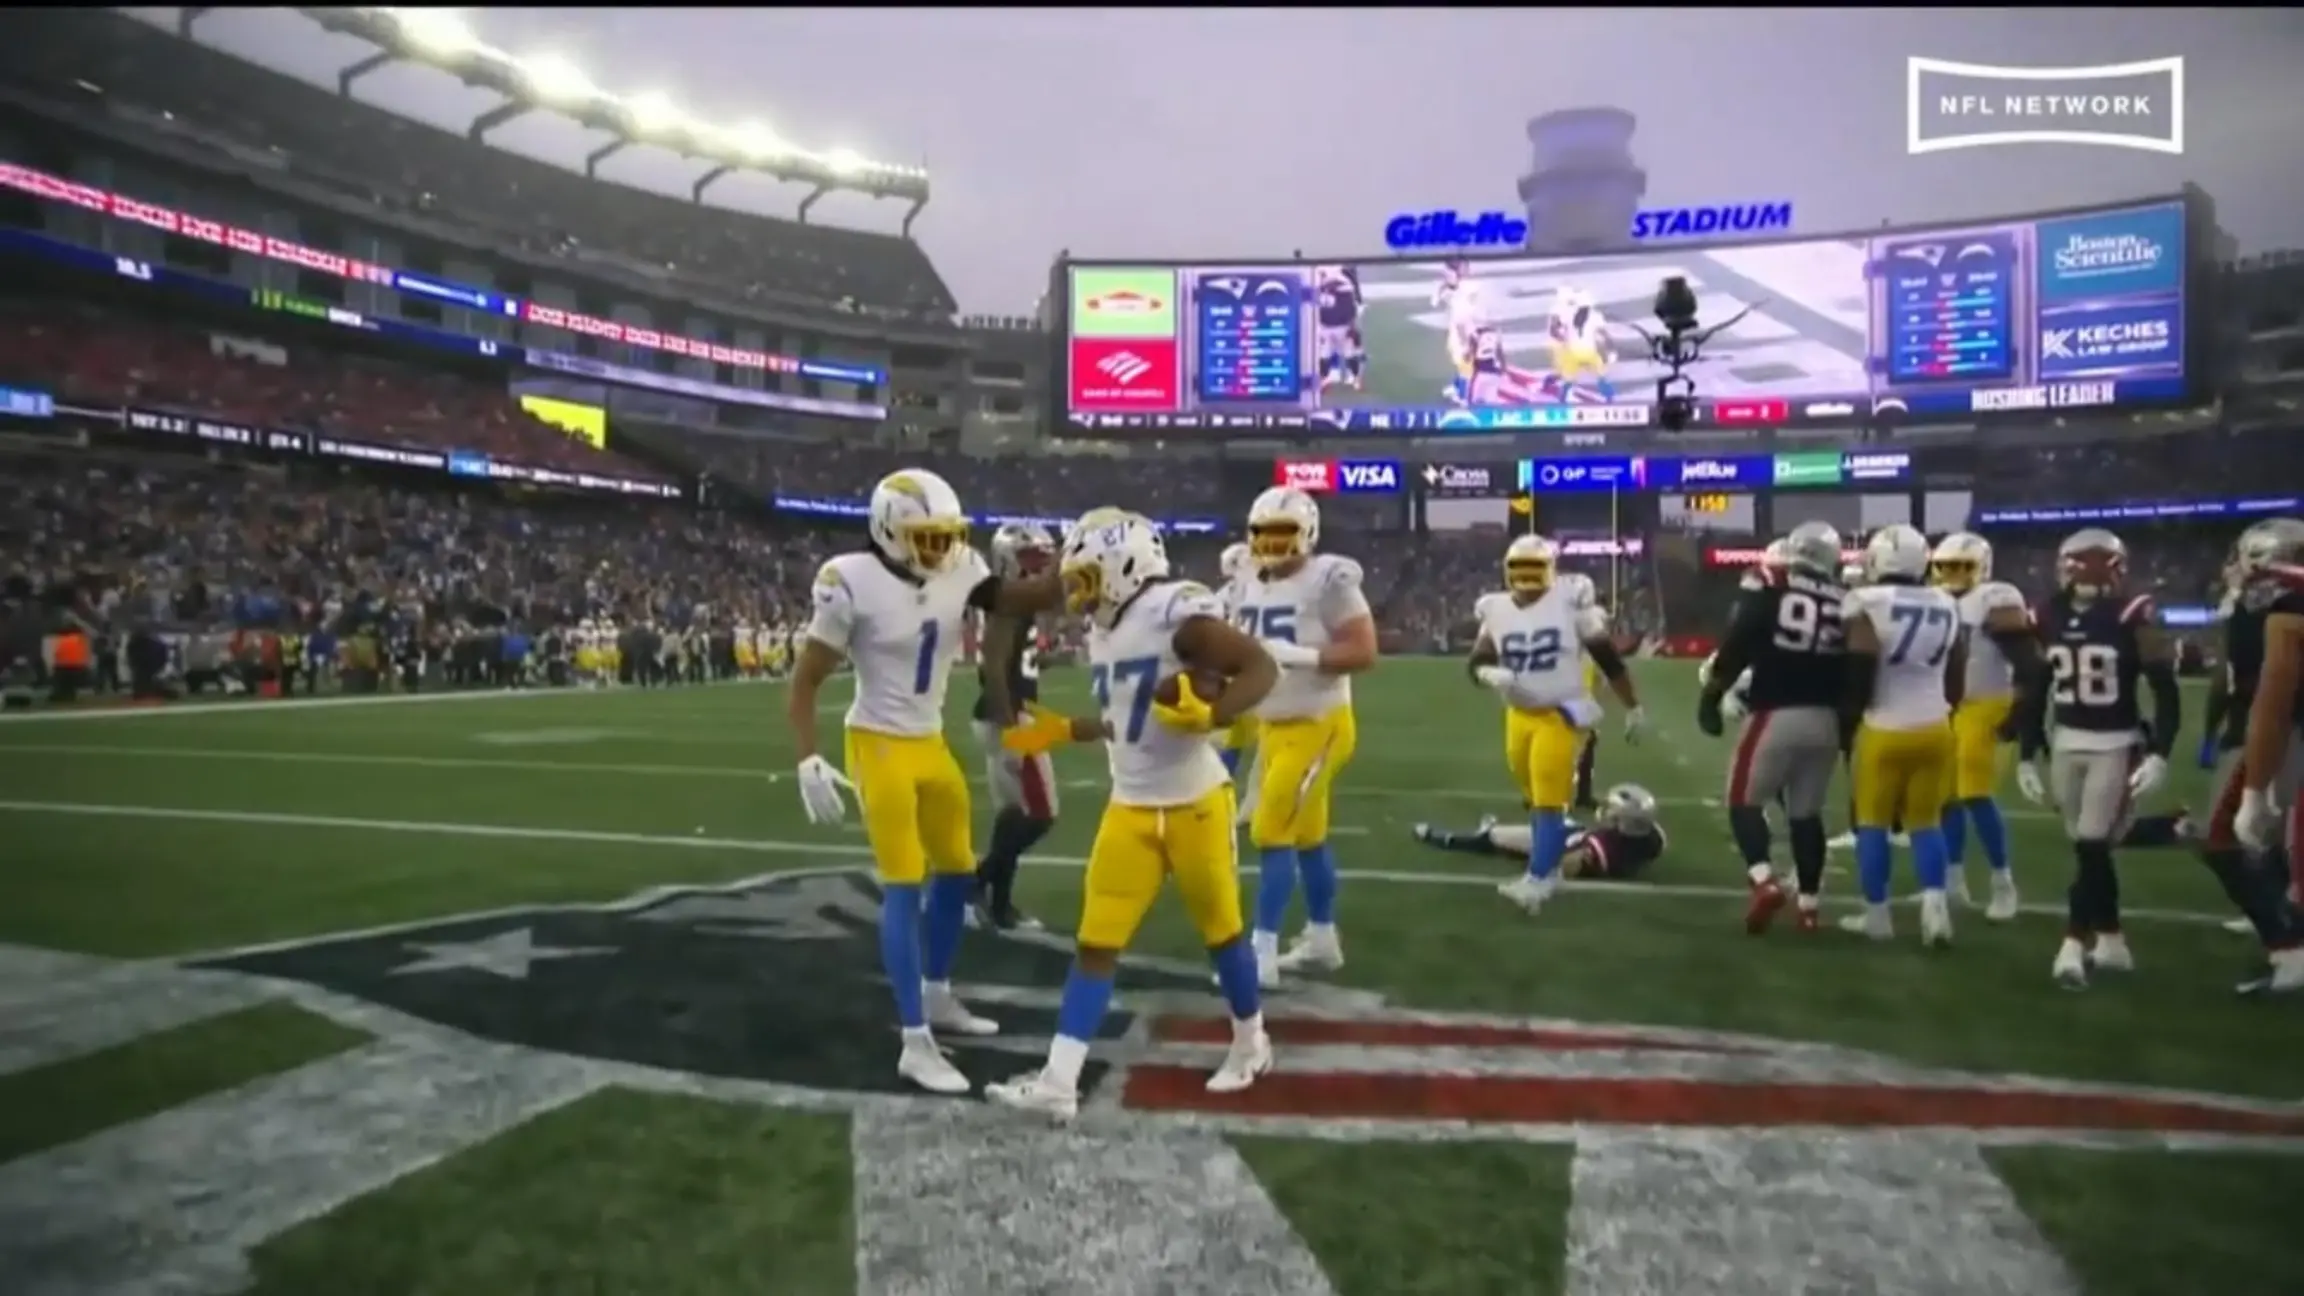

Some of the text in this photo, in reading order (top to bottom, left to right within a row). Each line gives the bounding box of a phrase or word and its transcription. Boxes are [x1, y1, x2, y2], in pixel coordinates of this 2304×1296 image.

[1385, 202, 1791, 247] Gillette STADIUM
[2078, 320, 2169, 344] KECHES
[2050, 382, 2116, 408] LEADER
[1340, 465, 1396, 487] VISA
[1682, 461, 1738, 480] jetBlue
[914, 618, 940, 695] 1
[1501, 626, 1561, 672] 62
[1889, 605, 1953, 665] 77
[2046, 644, 2119, 705] 28
